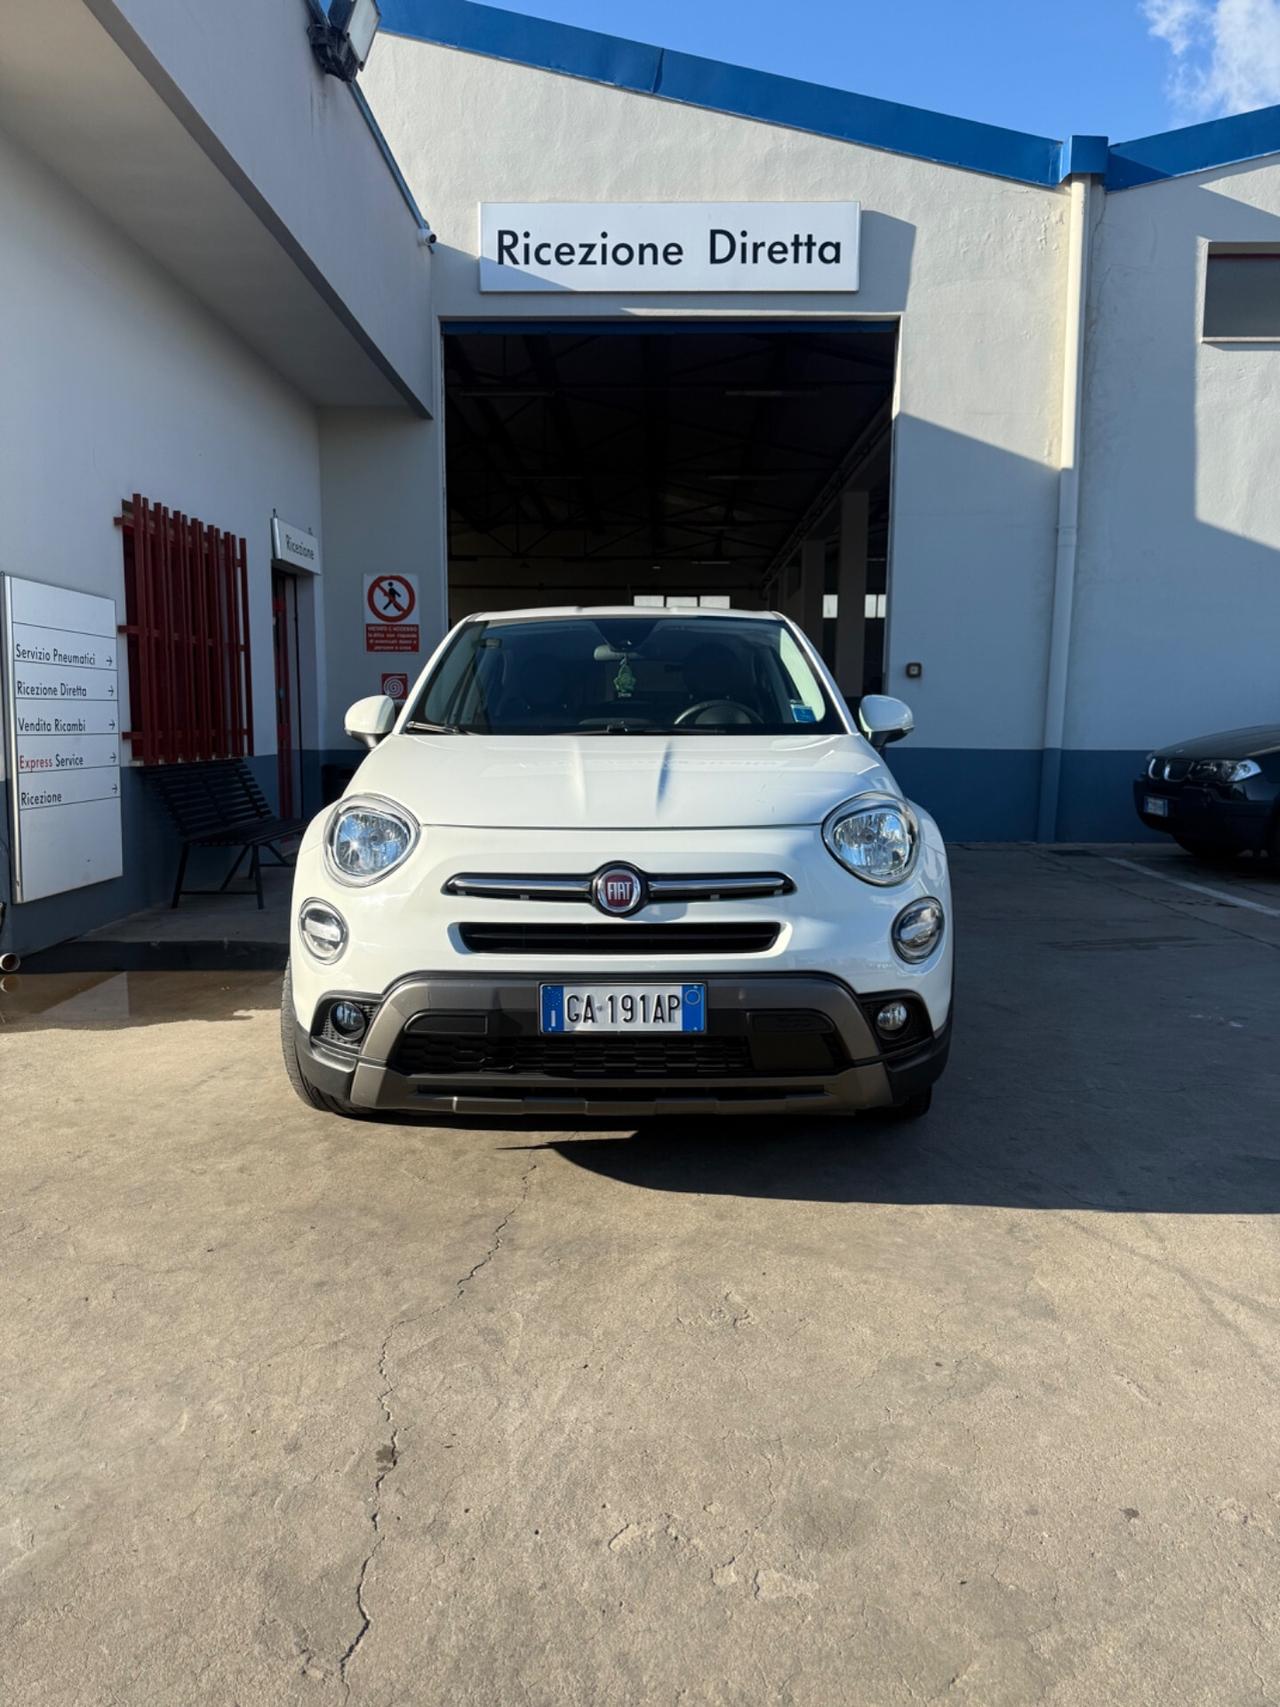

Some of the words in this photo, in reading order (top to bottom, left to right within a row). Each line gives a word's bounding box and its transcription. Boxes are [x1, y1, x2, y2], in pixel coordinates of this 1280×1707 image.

[497, 229, 684, 266] Ricezione
[708, 228, 842, 265] Diretta
[285, 533, 314, 560] Ricezione
[16, 643, 51, 661] Servizio
[53, 647, 96, 665] Pneumatici
[17, 680, 58, 696] Ricezione
[60, 682, 87, 697] Diretta
[18, 717, 52, 732] Vendita
[54, 718, 86, 732] Ricambi
[19, 755, 53, 773] Express
[55, 753, 84, 767] Service
[21, 790, 62, 806] Ricezione
[607, 881, 632, 900] FIAT
